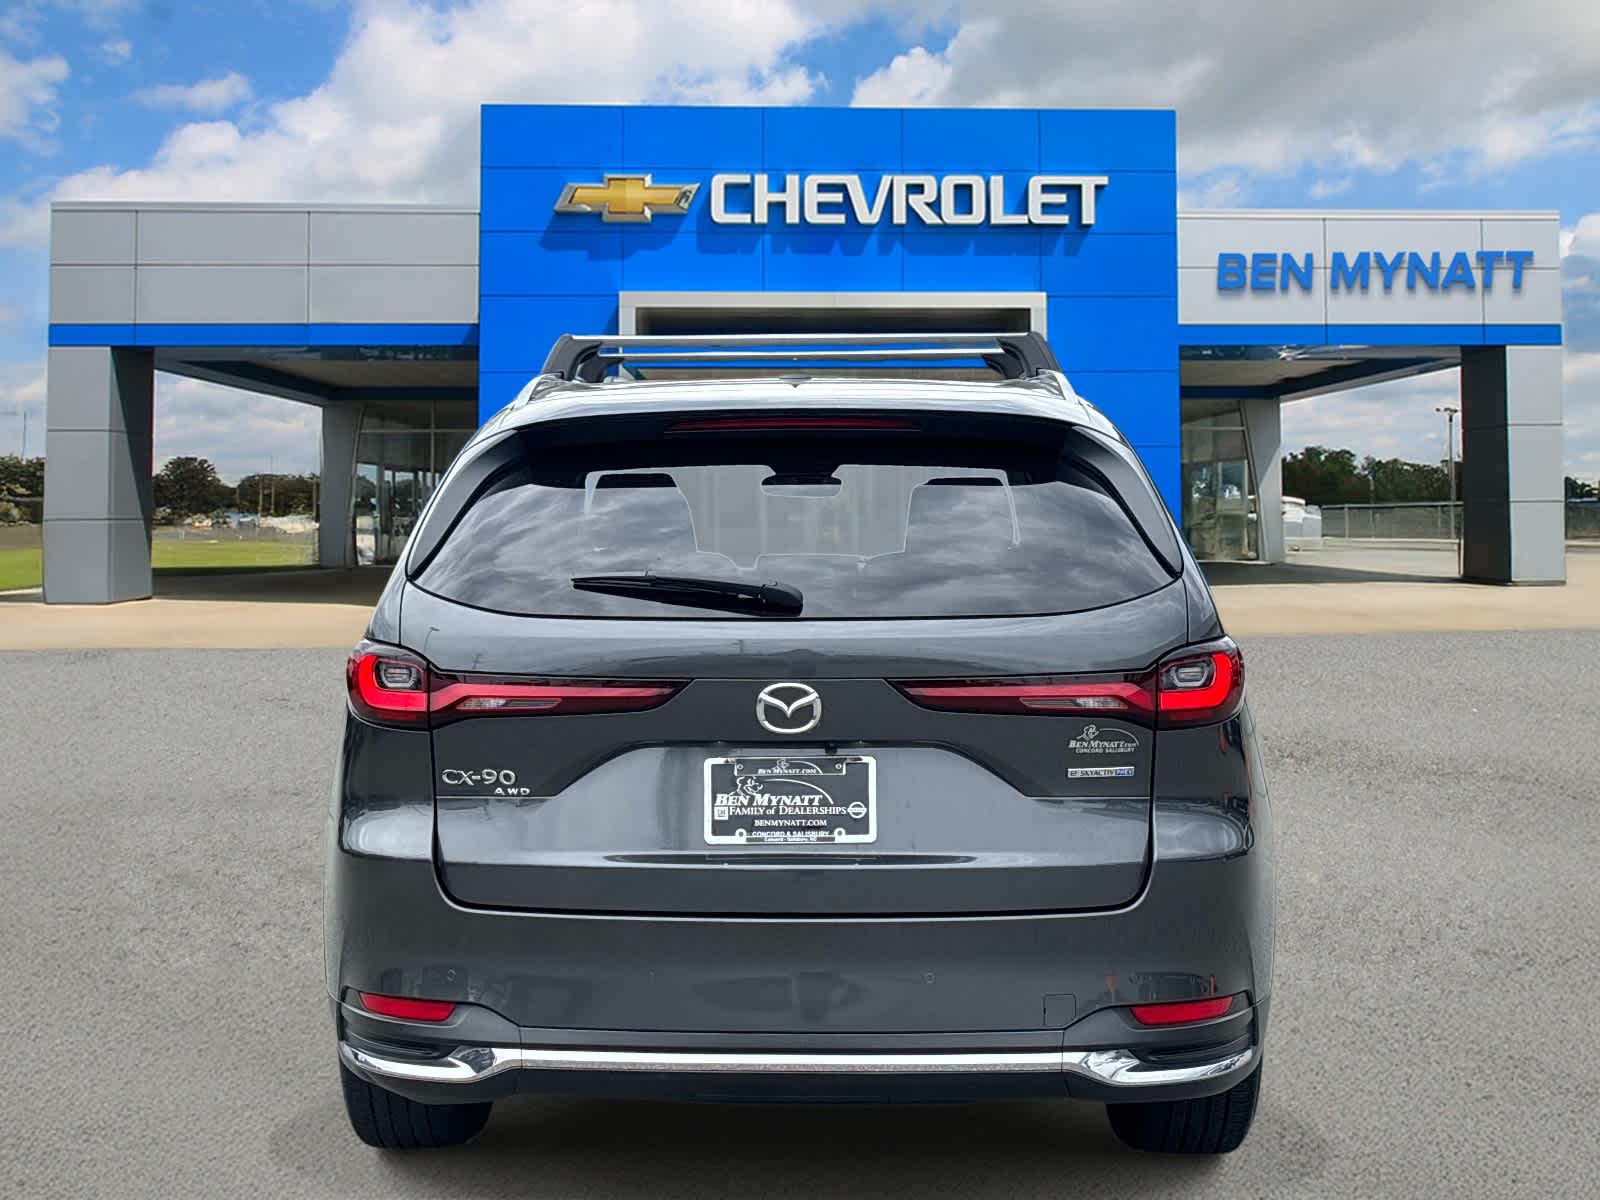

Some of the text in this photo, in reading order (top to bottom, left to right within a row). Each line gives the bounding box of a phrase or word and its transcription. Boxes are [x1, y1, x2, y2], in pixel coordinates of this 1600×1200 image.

[711, 173, 1108, 225] CHEVROLET
[1217, 251, 1534, 290] BEN MYNATT
[442, 769, 516, 785] CX-90
[494, 787, 530, 795] AWD
[714, 793, 823, 806] BEN MYNATT
[729, 806, 764, 815] FAMILY
[766, 807, 776, 815] of
[779, 805, 847, 815] DEALERSHIPS
[754, 819, 827, 827] BENMYNATT.COM
